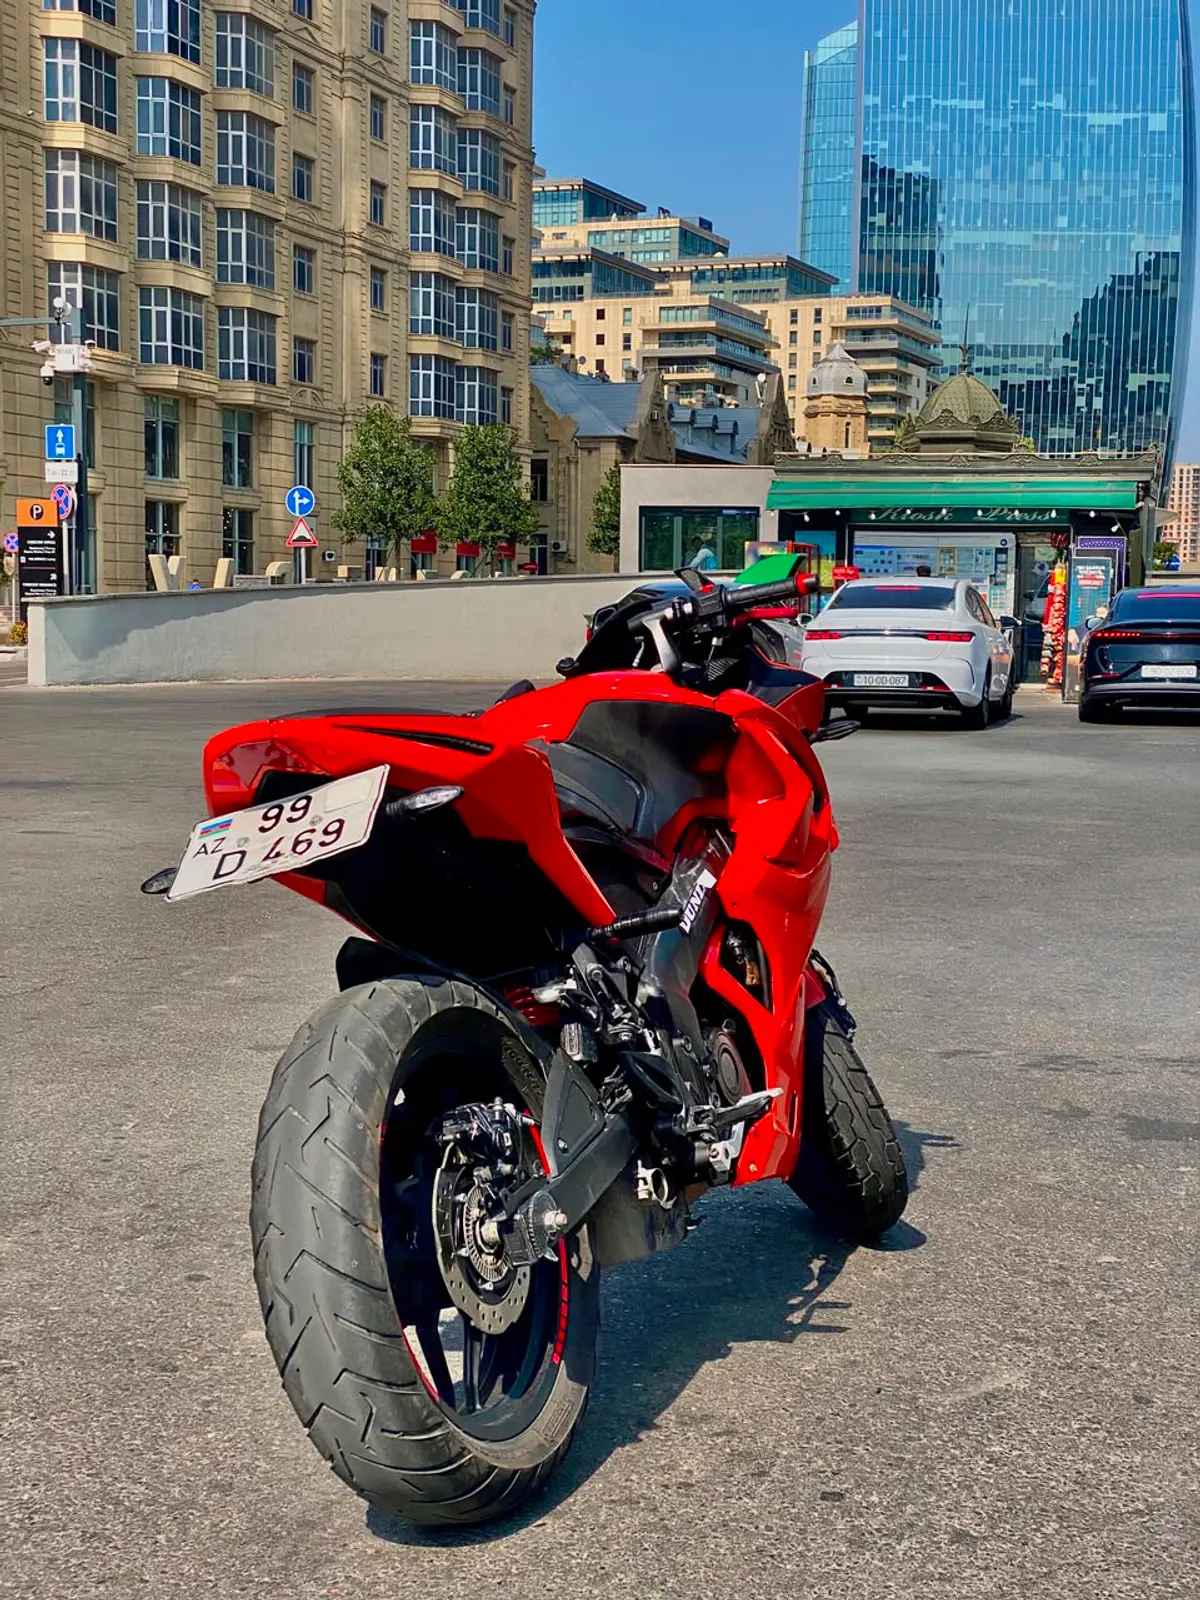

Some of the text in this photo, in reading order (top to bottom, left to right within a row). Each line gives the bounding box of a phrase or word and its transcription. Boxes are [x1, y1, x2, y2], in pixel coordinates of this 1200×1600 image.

[32, 504, 42, 519] P
[875, 506, 1050, 521] Kiosk Press
[258, 794, 313, 834] 99
[192, 836, 227, 859] AZ
[212, 818, 346, 880] D 469
